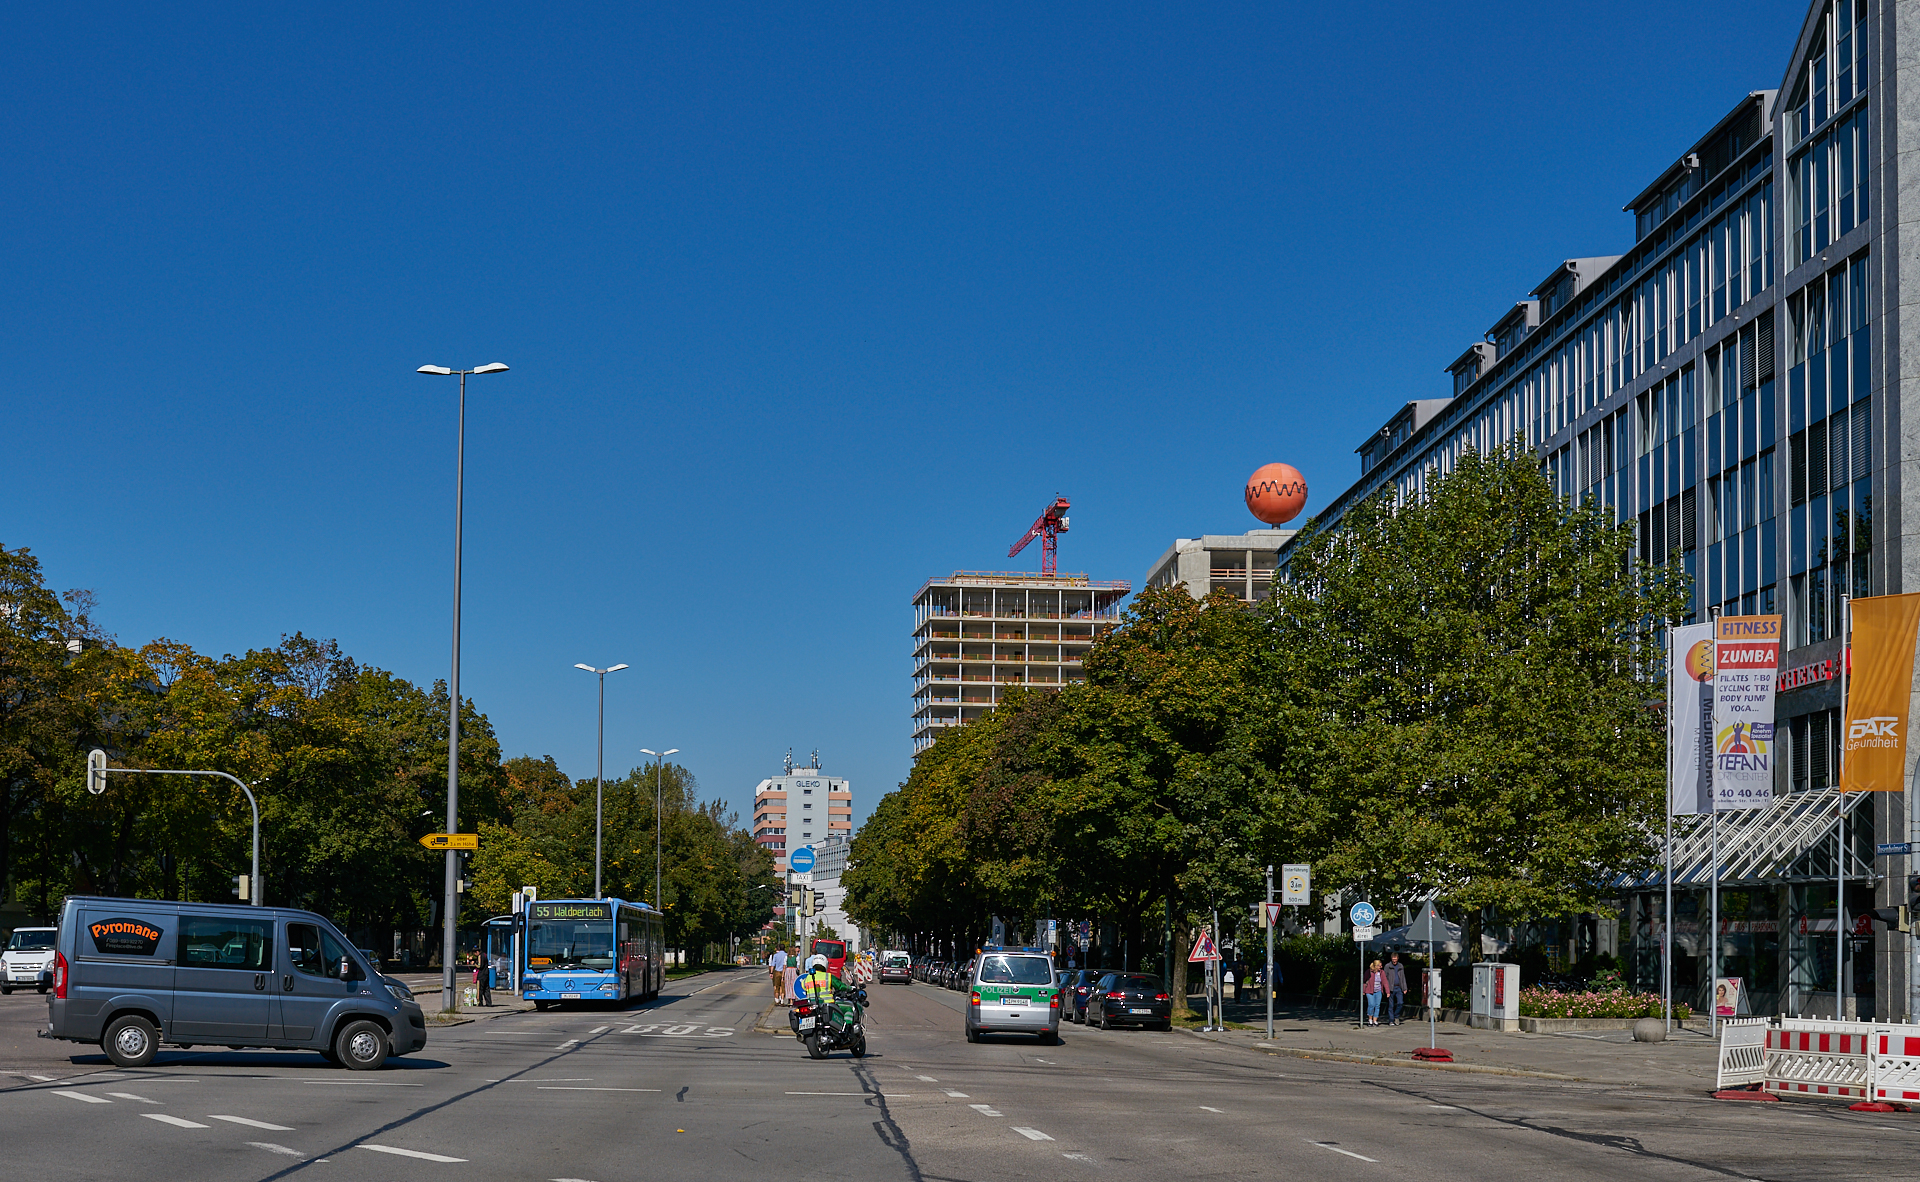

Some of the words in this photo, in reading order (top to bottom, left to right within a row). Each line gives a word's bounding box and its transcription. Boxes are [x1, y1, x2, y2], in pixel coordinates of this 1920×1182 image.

[1722, 621, 1777, 635] FITNESS
[1720, 649, 1774, 664] ZUMBA
[1776, 660, 1832, 693] THEKE
[1849, 716, 1899, 738] DAK
[1846, 736, 1899, 751] Geundheit
[1717, 754, 1768, 771] TEFAN
[1716, 772, 1733, 780] ORT
[1735, 772, 1768, 781] CENTER
[1719, 789, 1734, 798] 40
[1738, 789, 1752, 798] 40
[1755, 789, 1769, 798] 46
[536, 906, 550, 917] 55
[554, 906, 603, 917] Waldperlach
[91, 922, 159, 941] Pyromane
[1751, 922, 1778, 931] PHARMACY
[981, 986, 1011, 994] POLIZEI
